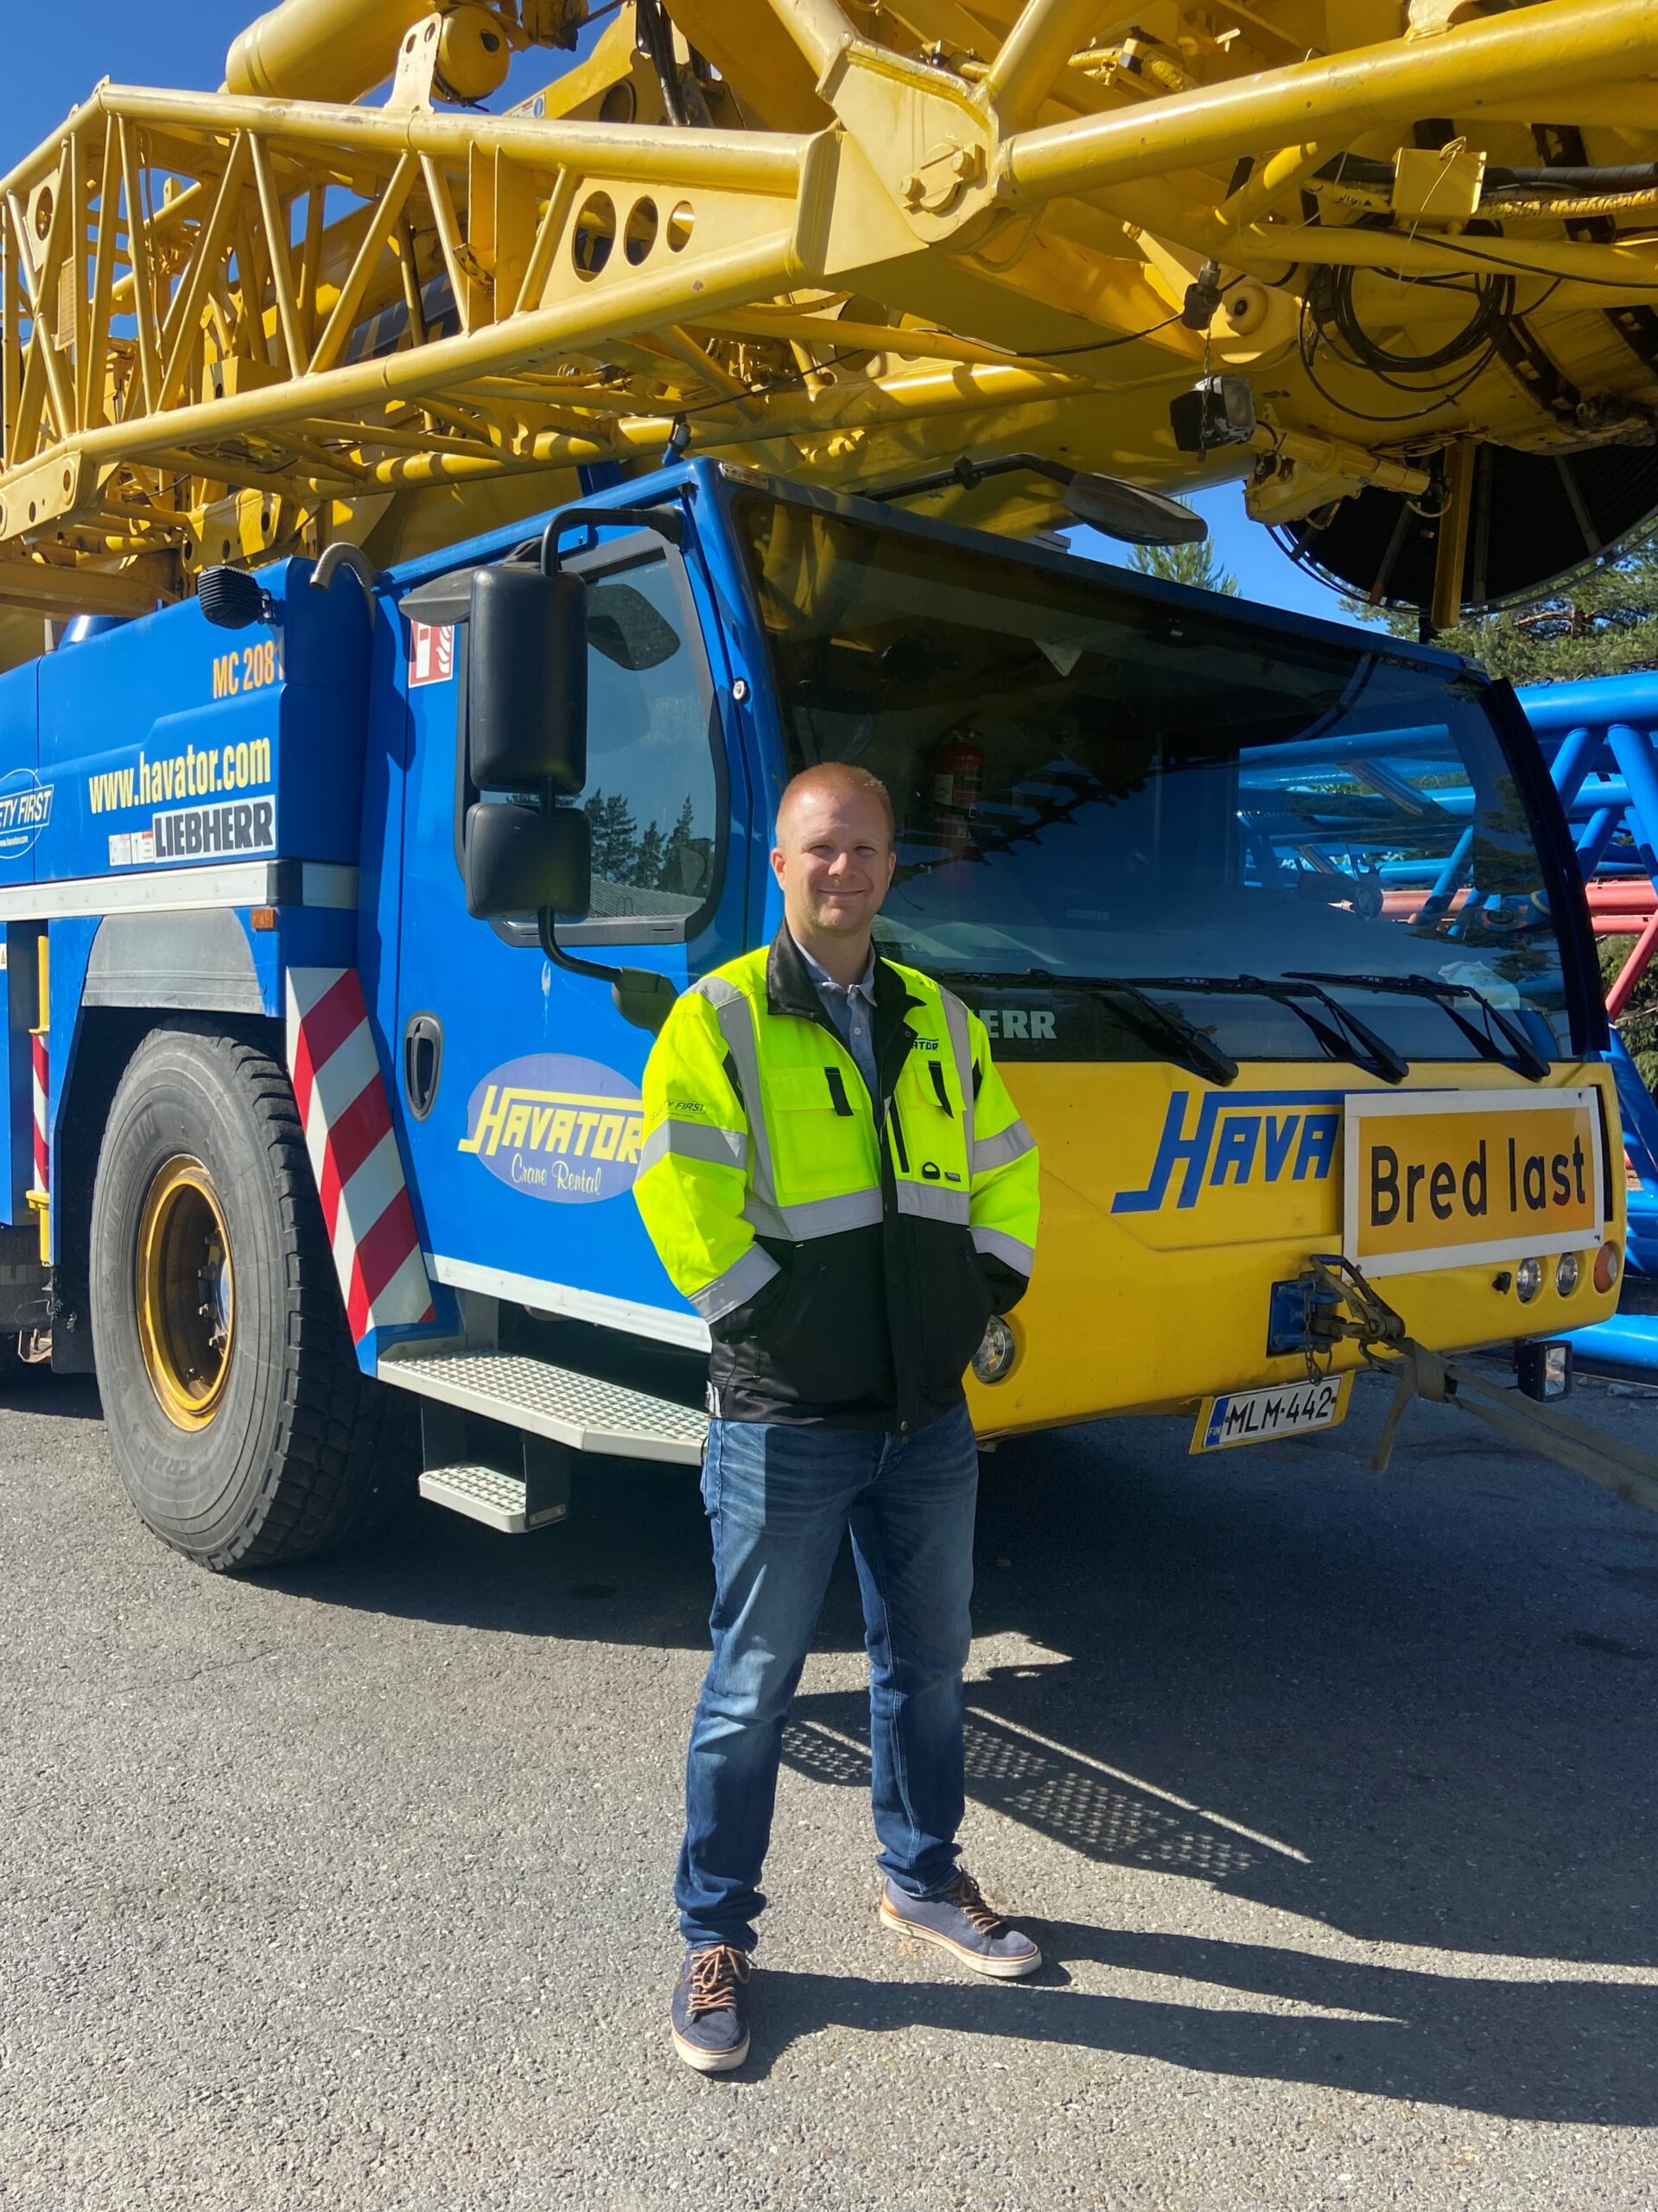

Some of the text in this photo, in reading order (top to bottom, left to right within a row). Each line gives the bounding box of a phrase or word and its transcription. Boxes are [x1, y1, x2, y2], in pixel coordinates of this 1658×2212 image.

[213, 652, 238, 699] MC
[88, 737, 270, 814] www.havator.com
[17, 790, 52, 824] FIRST
[154, 801, 273, 858] LIEBHERR
[971, 1009, 1058, 1039] ERR
[457, 1084, 645, 1164] HAVATOR
[676, 1102, 705, 1112] FIRST
[511, 1153, 601, 1196] Crane Rental
[1110, 1088, 1343, 1214] HAVA
[1370, 1134, 1586, 1227] Bred last
[1208, 1386, 1333, 1438] FIN MLM-442
